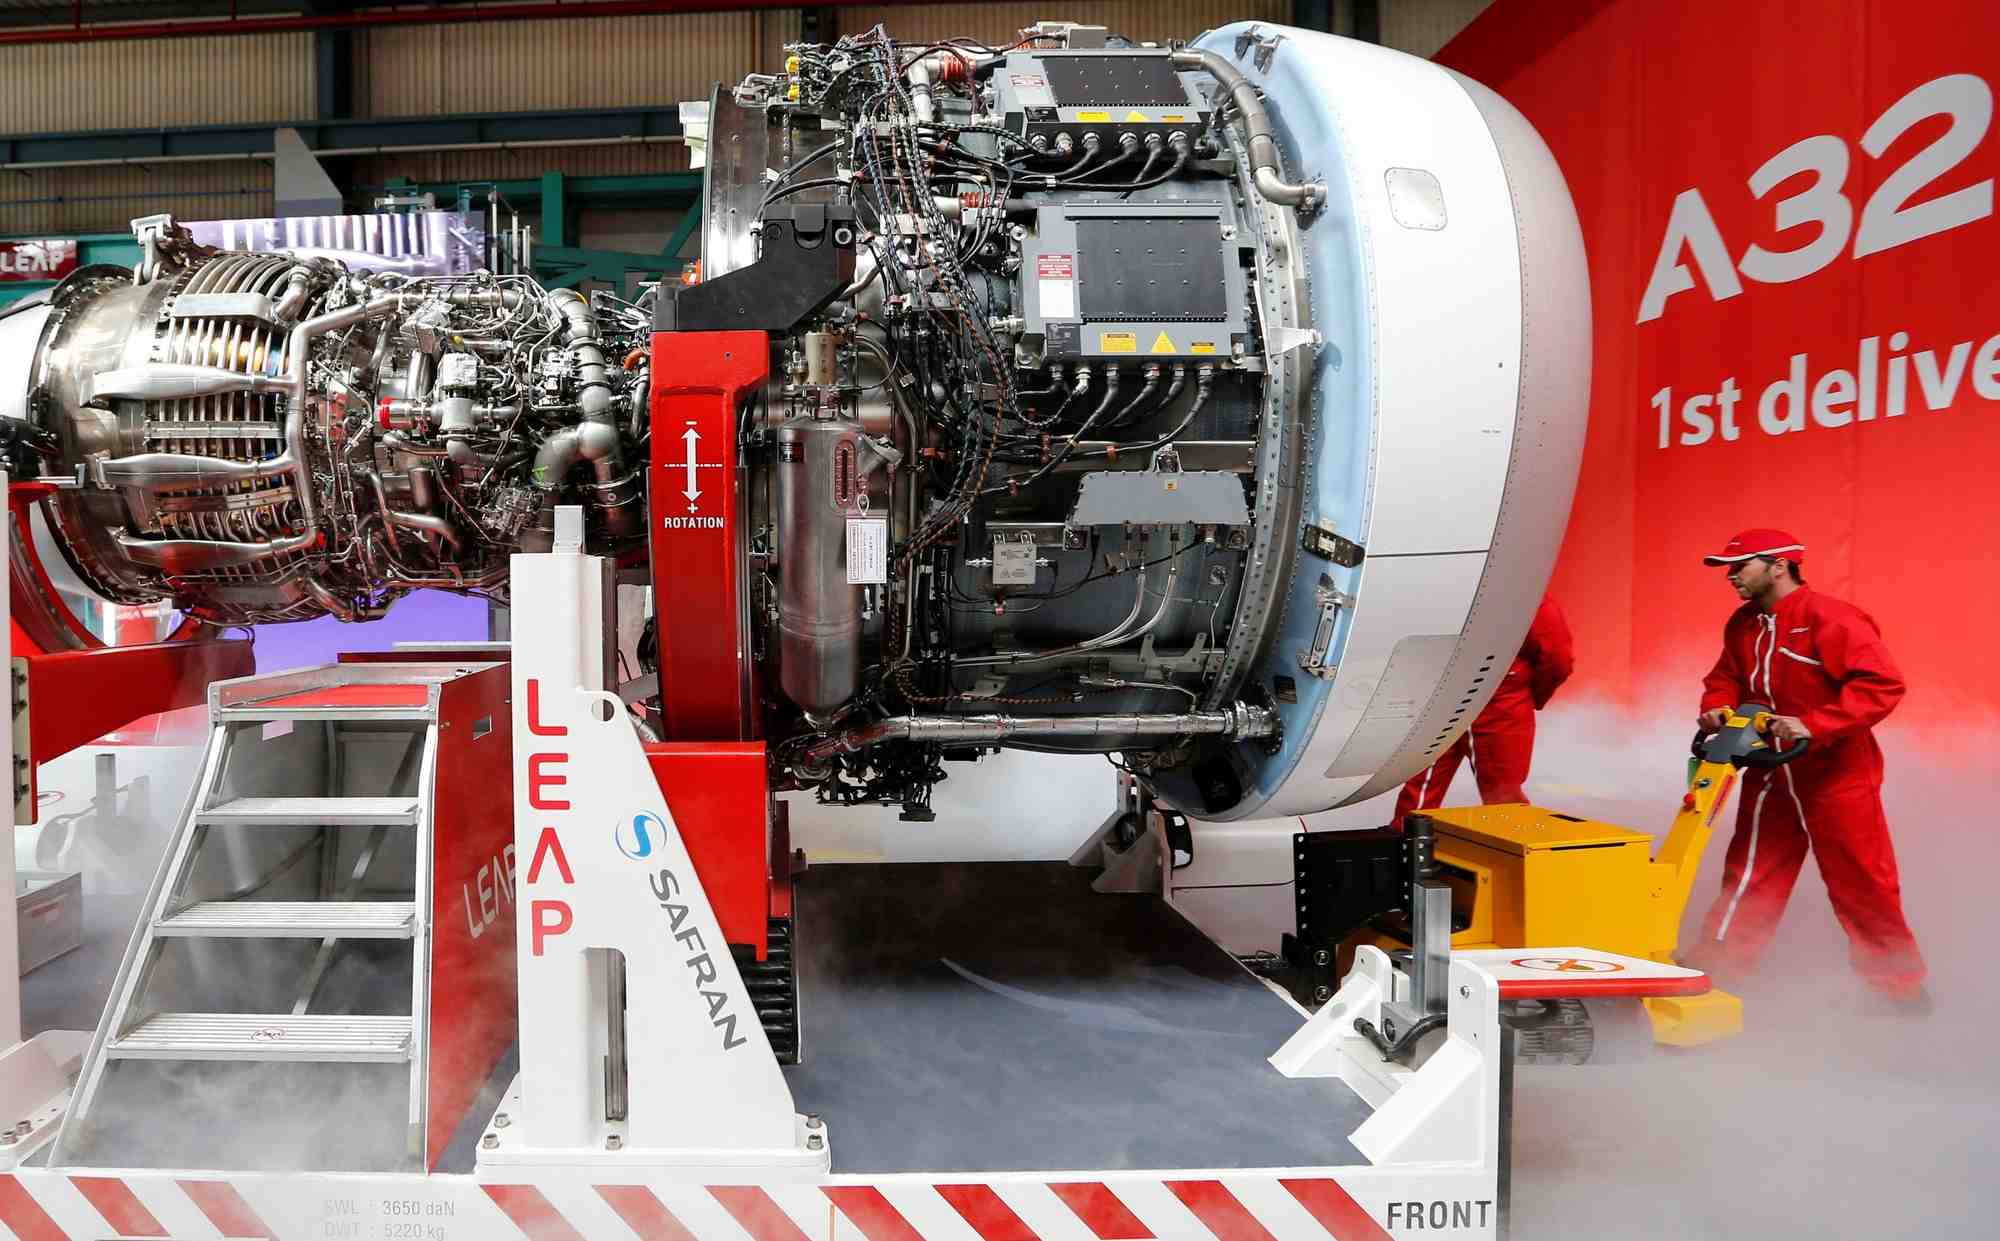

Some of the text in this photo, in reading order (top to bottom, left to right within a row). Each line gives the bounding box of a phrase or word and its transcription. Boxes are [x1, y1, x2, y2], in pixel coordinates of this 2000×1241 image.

[1636, 74, 1994, 326] A32
[1651, 377, 1741, 449] 1st
[664, 517, 724, 529] ROTATION
[650, 868, 747, 1051] SAFRAN
[383, 1200, 421, 1216] 3650
[426, 1200, 455, 1216] daN
[1388, 1200, 1491, 1230] FRONT
[384, 1223, 422, 1238] 5220
[427, 1223, 445, 1241] kg
